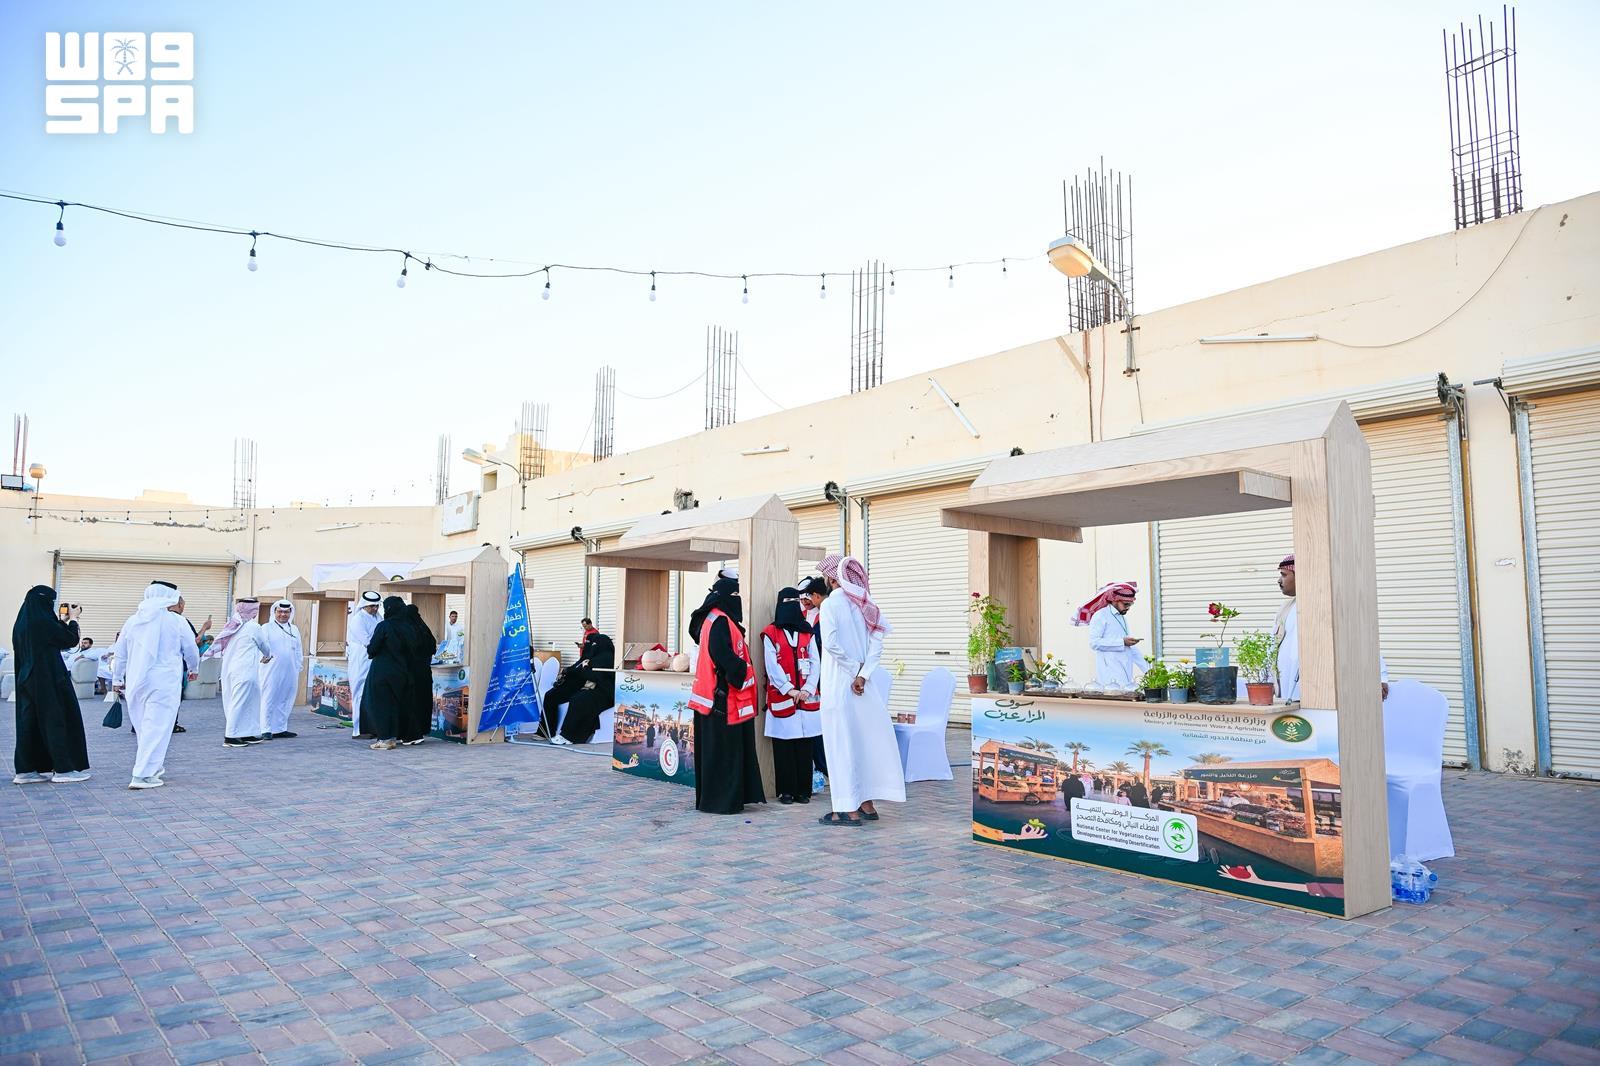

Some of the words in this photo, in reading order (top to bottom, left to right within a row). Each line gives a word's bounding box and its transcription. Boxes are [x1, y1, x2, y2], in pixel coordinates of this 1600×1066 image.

[984, 709, 1046, 723] المزارعين
[1144, 710, 1178, 720] والزراعة
[1179, 712, 1213, 722] والمياه
[1214, 714, 1240, 724] البيئة
[1243, 716, 1267, 726] وزارة
[1076, 802, 1102, 813] للتنمية
[1076, 814, 1096, 822] التصحر
[1102, 808, 1128, 818] الوطني
[1130, 812, 1160, 822] المركز
[1097, 816, 1122, 828] ومكافحة
[1122, 820, 1139, 830] النباتي
[1140, 824, 1160, 832] الغطاء
[1076, 830, 1102, 840] Development
[1106, 835, 1128, 844] Combating
[1128, 840, 1160, 850] Desertification
[1119, 830, 1144, 840] Vegetation
